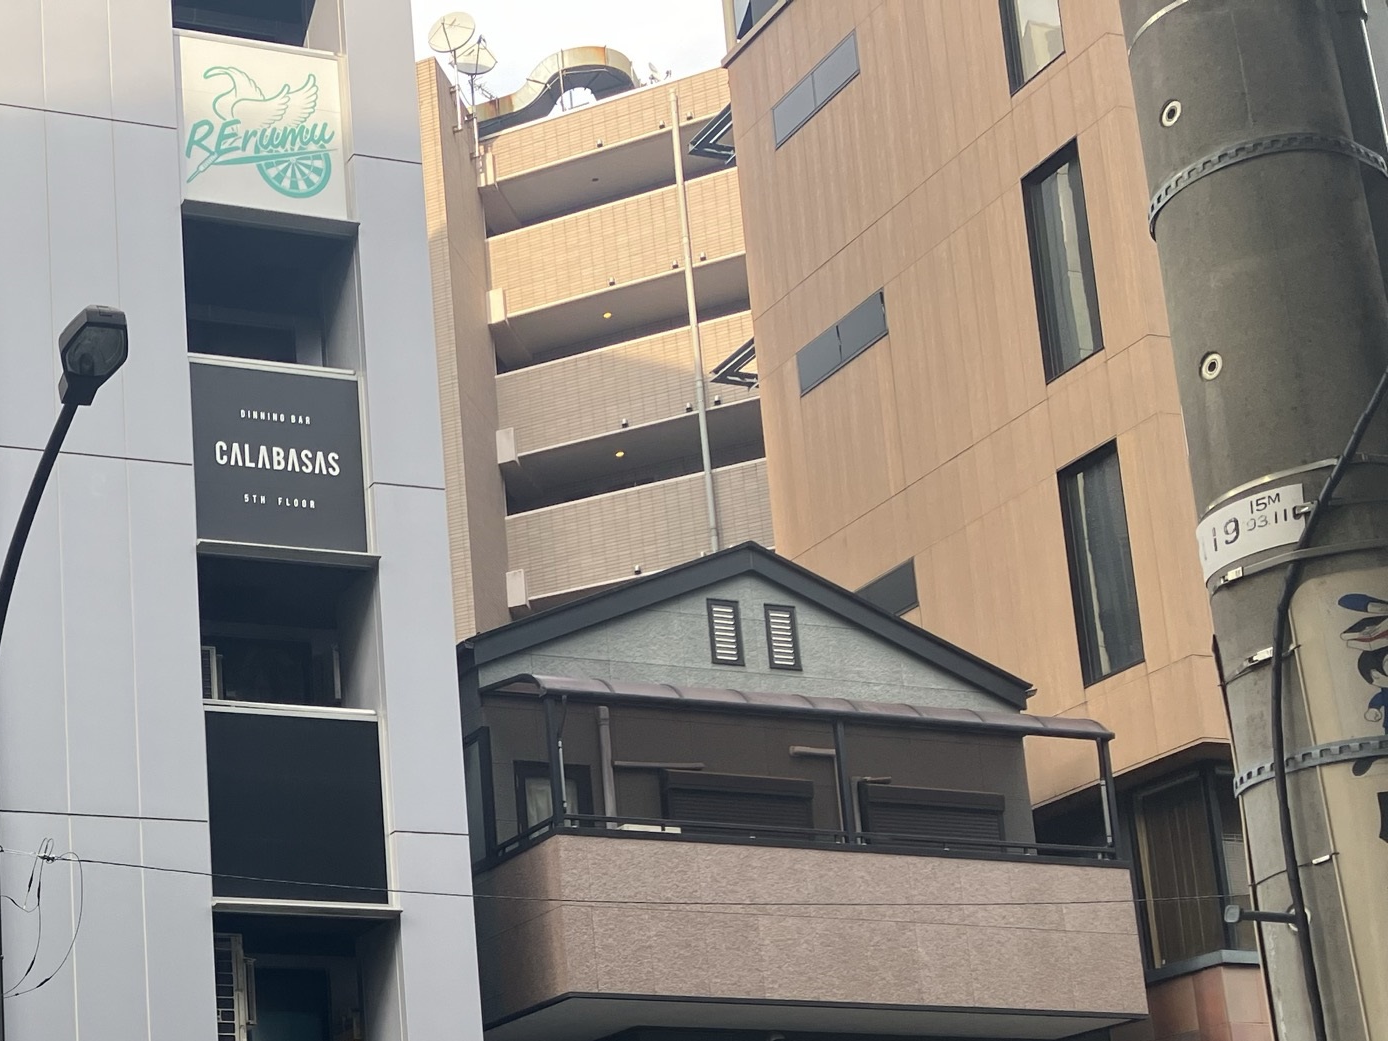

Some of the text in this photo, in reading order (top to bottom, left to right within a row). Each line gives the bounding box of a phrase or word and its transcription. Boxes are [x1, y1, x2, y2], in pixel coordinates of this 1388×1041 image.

[290, 414, 311, 425] BAR
[215, 440, 341, 476] CALABASAS
[244, 493, 316, 509] 5TH FLOOR
